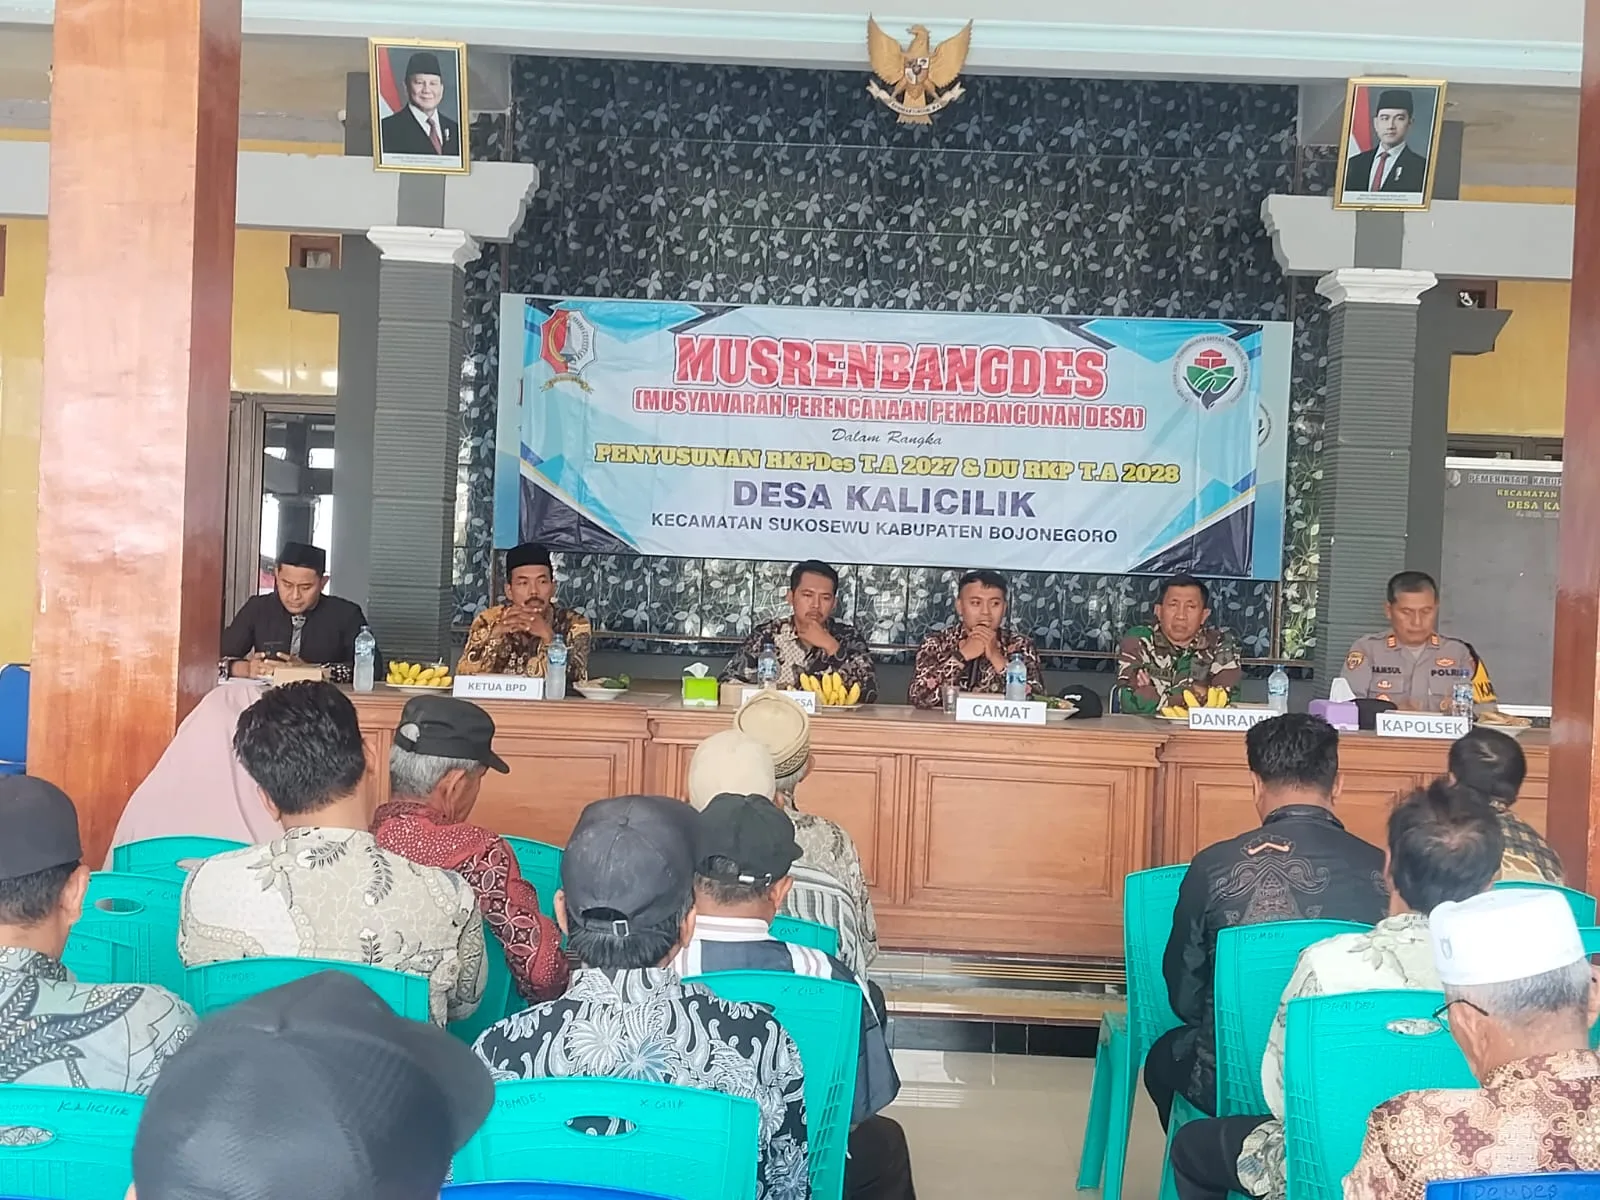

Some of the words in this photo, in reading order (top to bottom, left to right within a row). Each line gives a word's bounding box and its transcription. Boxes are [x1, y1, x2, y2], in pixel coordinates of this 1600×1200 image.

[675, 335, 1107, 398] MUSRENBANGDES
[635, 388, 783, 416] (MUSYAWARAH
[787, 395, 928, 423] PERENCANAAN
[931, 399, 1081, 428] PEMBANGUNAN
[1085, 405, 1145, 431] DESA)
[832, 428, 880, 442] Dalam
[888, 431, 942, 448] Rangka
[595, 443, 761, 468] PENYUSUNAN
[766, 450, 855, 472] RKPDes
[860, 453, 898, 474] T.A
[902, 456, 959, 477] 2027
[961, 458, 980, 477] &
[985, 459, 1019, 479] DU
[1023, 460, 1074, 481] RKP
[1079, 462, 1118, 482] T.A
[1121, 463, 1180, 483] 2028
[1468, 473, 1528, 485] PEMERINTAH
[733, 481, 832, 510] DESA
[846, 485, 1036, 518] KALICILIK
[1497, 489, 1557, 498] KECAMATAN
[1507, 501, 1538, 510] DESA
[652, 513, 762, 530] KECAMATAN
[768, 517, 870, 535] SUKOSEWU
[876, 521, 982, 539] KABUPATEN
[989, 526, 1118, 543] BOJONEGORO
[468, 682, 503, 692] KETUA
[505, 684, 527, 693] BPD
[973, 705, 1031, 720] CAMAT
[1382, 719, 1464, 735] KAPOLSEK
